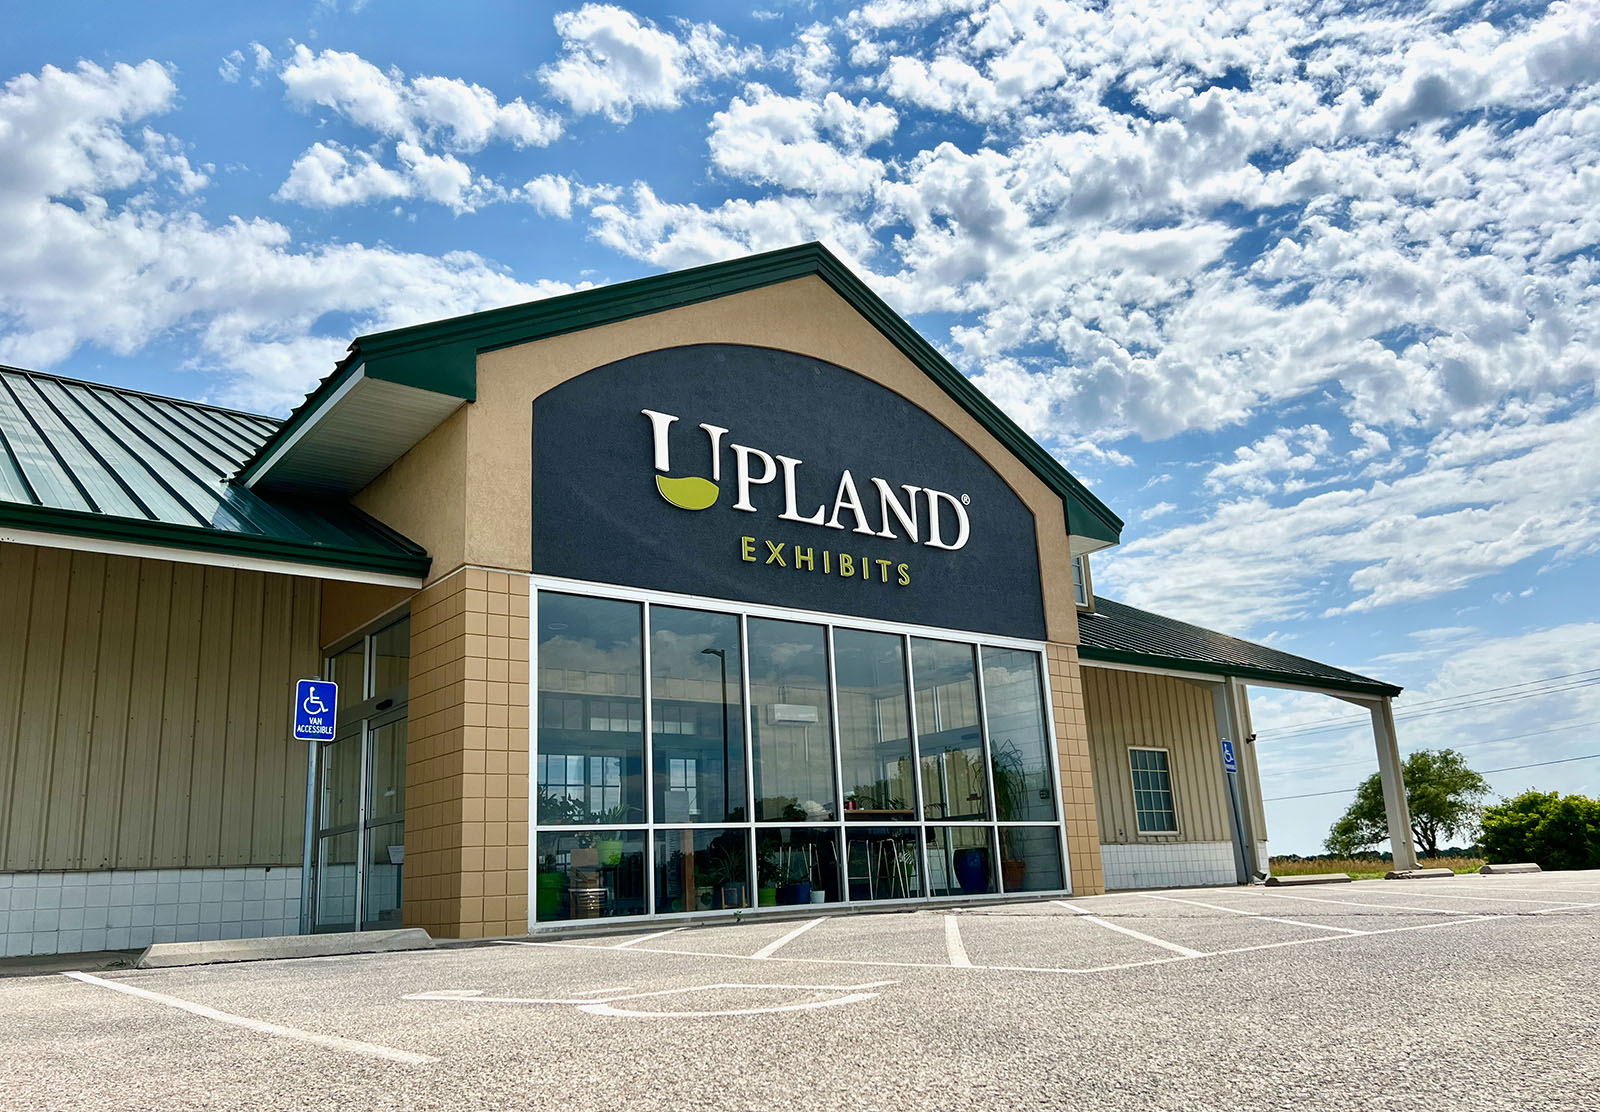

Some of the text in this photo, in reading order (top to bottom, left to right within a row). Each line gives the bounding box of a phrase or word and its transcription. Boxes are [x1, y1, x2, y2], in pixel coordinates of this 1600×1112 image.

[741, 536, 911, 586] EXHIBITS
[309, 717, 323, 725] VAN
[297, 725, 333, 735] ACCESSIBLE
